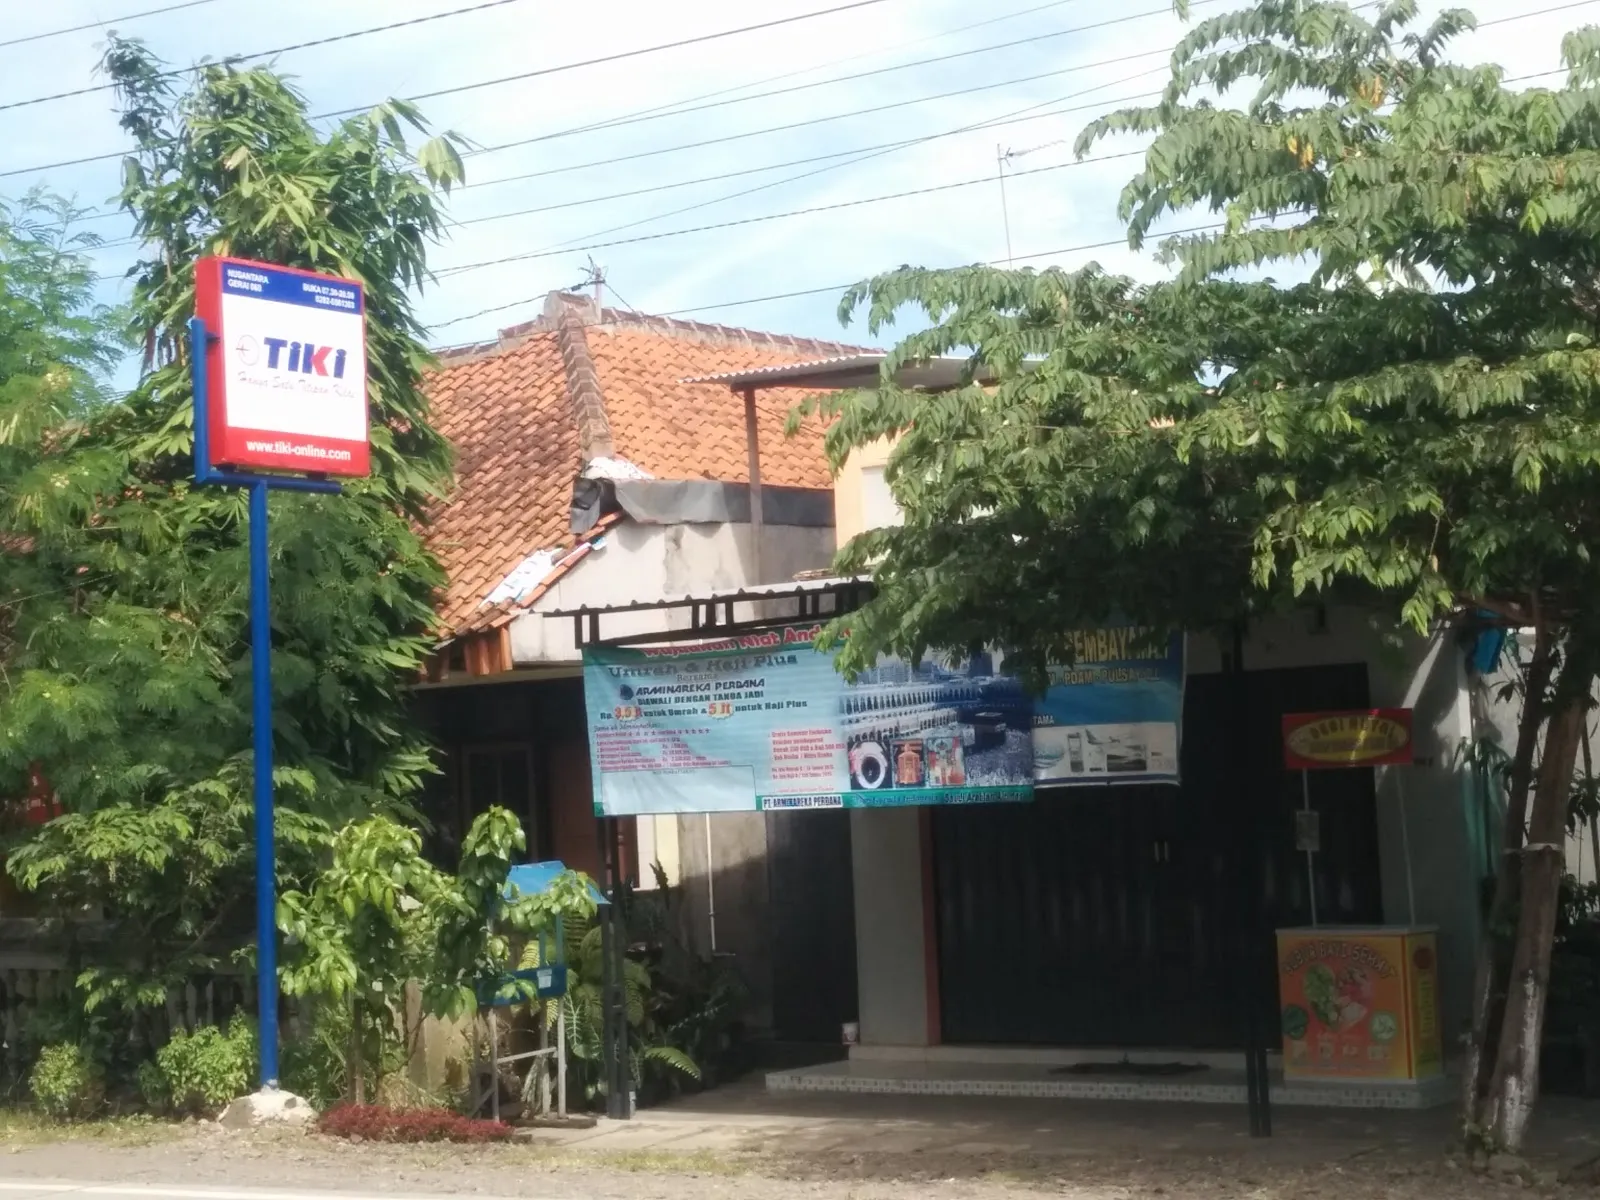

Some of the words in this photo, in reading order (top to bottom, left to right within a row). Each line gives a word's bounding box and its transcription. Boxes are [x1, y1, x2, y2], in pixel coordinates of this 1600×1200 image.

[246, 440, 351, 461] www.tiki-online.com
[739, 631, 780, 651] Niat
[784, 624, 824, 643] And
[608, 662, 679, 679] Umrah
[706, 656, 750, 675] Haji
[752, 653, 798, 669] Plus
[635, 682, 711, 696] ARMINAREKA
[715, 678, 766, 692] PERDANA
[637, 695, 671, 706] DIAWALI
[675, 694, 711, 704] DENGAN
[713, 692, 742, 702] TANDA
[744, 690, 765, 699] JADI
[668, 706, 699, 717] Umrah
[708, 703, 717, 715] 5
[734, 703, 763, 712] untuk
[765, 701, 784, 711] Haji
[786, 700, 808, 709] Plus
